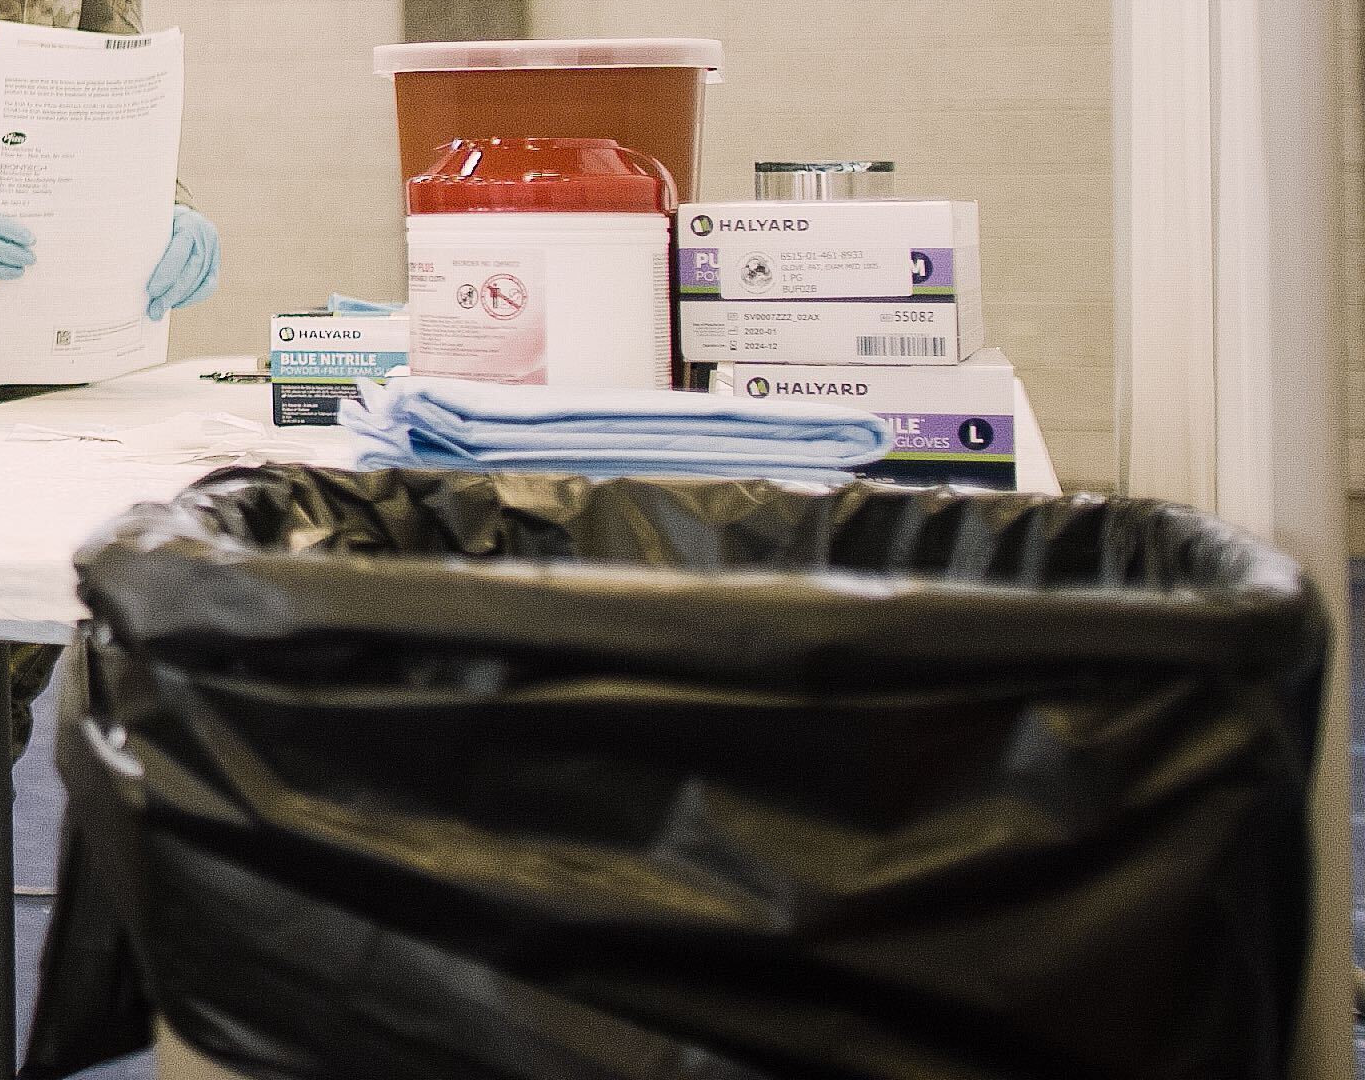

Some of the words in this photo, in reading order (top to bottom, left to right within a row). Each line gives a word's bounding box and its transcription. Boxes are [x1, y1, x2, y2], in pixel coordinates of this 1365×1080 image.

[719, 219, 810, 232] HALYARD
[911, 259, 926, 277] M
[299, 330, 361, 339] HALYARD
[744, 328, 778, 336] 2020-01
[744, 342, 778, 350] 2024-12
[280, 353, 318, 366] BLUE
[320, 353, 377, 366] NITRILE
[280, 366, 347, 375] POWDER-FREE
[348, 366, 372, 375] EXAM
[776, 382, 869, 396] HALYARD
[970, 425, 984, 443] L
[894, 436, 950, 449] GLOVES
